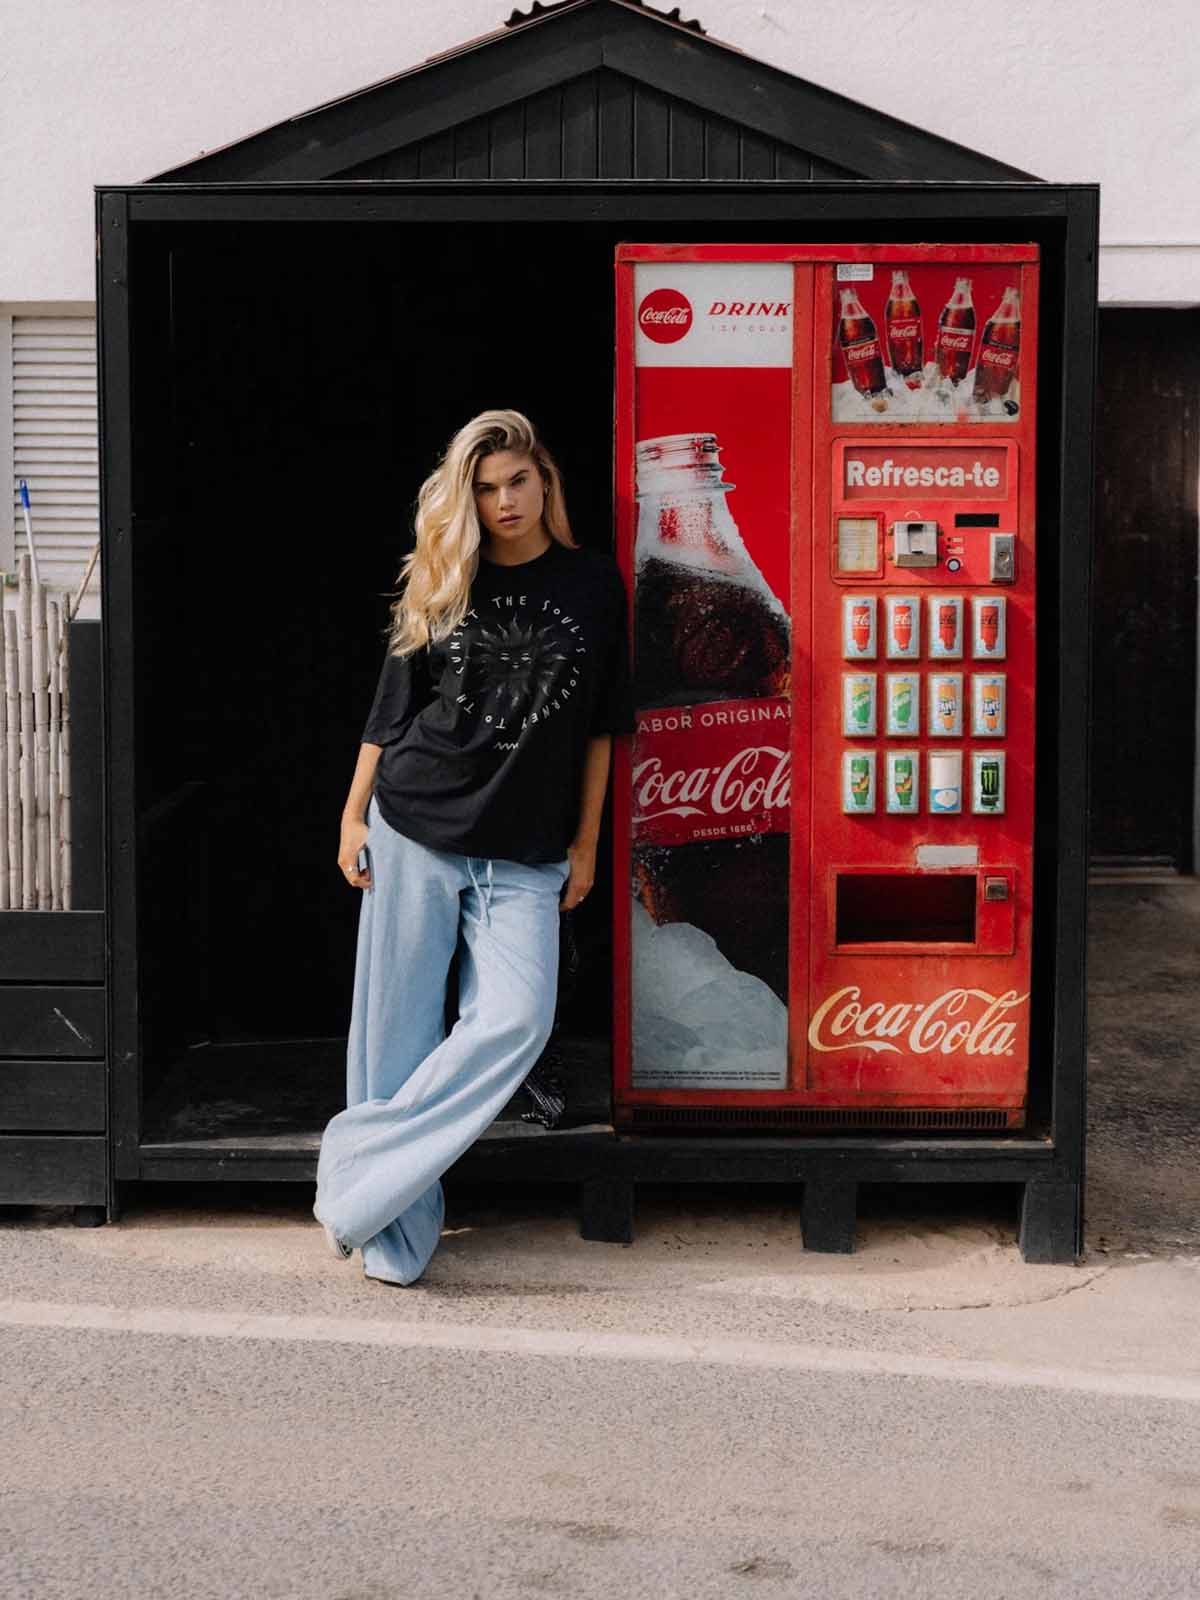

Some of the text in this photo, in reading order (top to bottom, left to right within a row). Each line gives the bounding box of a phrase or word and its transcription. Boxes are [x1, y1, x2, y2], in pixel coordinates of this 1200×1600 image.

[708, 302, 791, 317] DRINK
[847, 459, 999, 487] Refresca-te
[492, 595, 527, 608] THE
[485, 715, 507, 730] TO
[693, 826, 727, 837] DESDE
